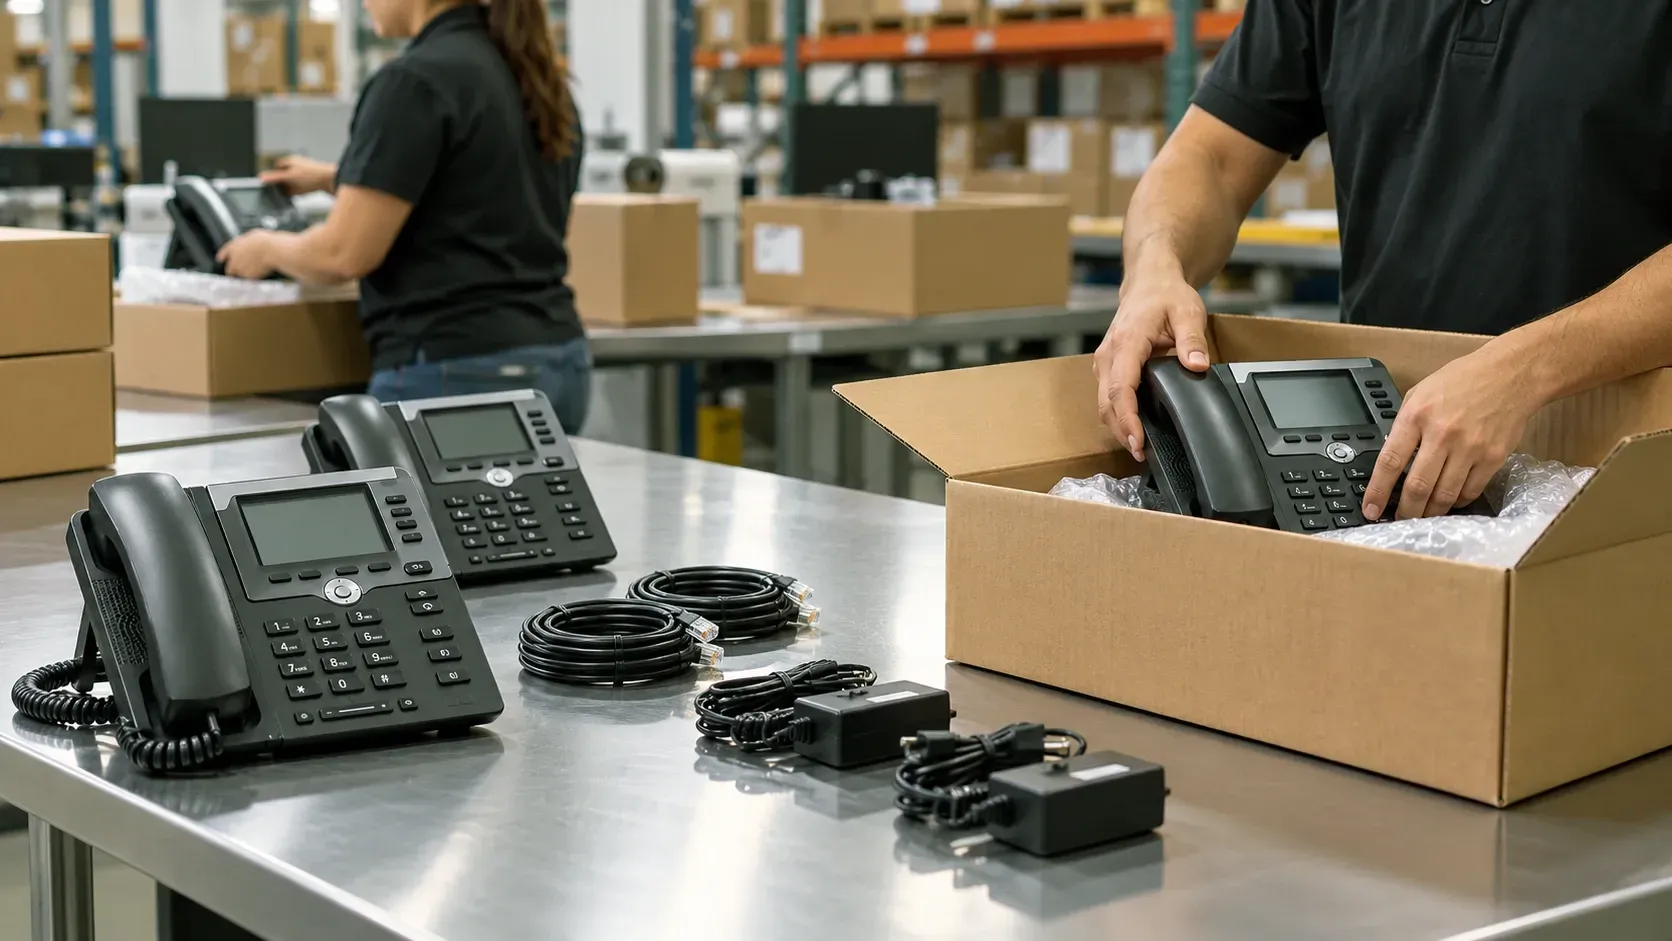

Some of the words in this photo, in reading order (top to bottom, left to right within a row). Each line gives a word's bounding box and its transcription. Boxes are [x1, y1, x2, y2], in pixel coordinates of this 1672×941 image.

[356, 611, 363, 620] 3
[274, 622, 280, 630] 1
[314, 617, 322, 626] 2
[364, 632, 371, 641] 6
[281, 642, 288, 651] 4
[322, 638, 330, 646] 5
[372, 653, 380, 662] 9
[330, 658, 338, 667] 8
[288, 664, 294, 672] 7
[338, 679, 346, 688] 0
